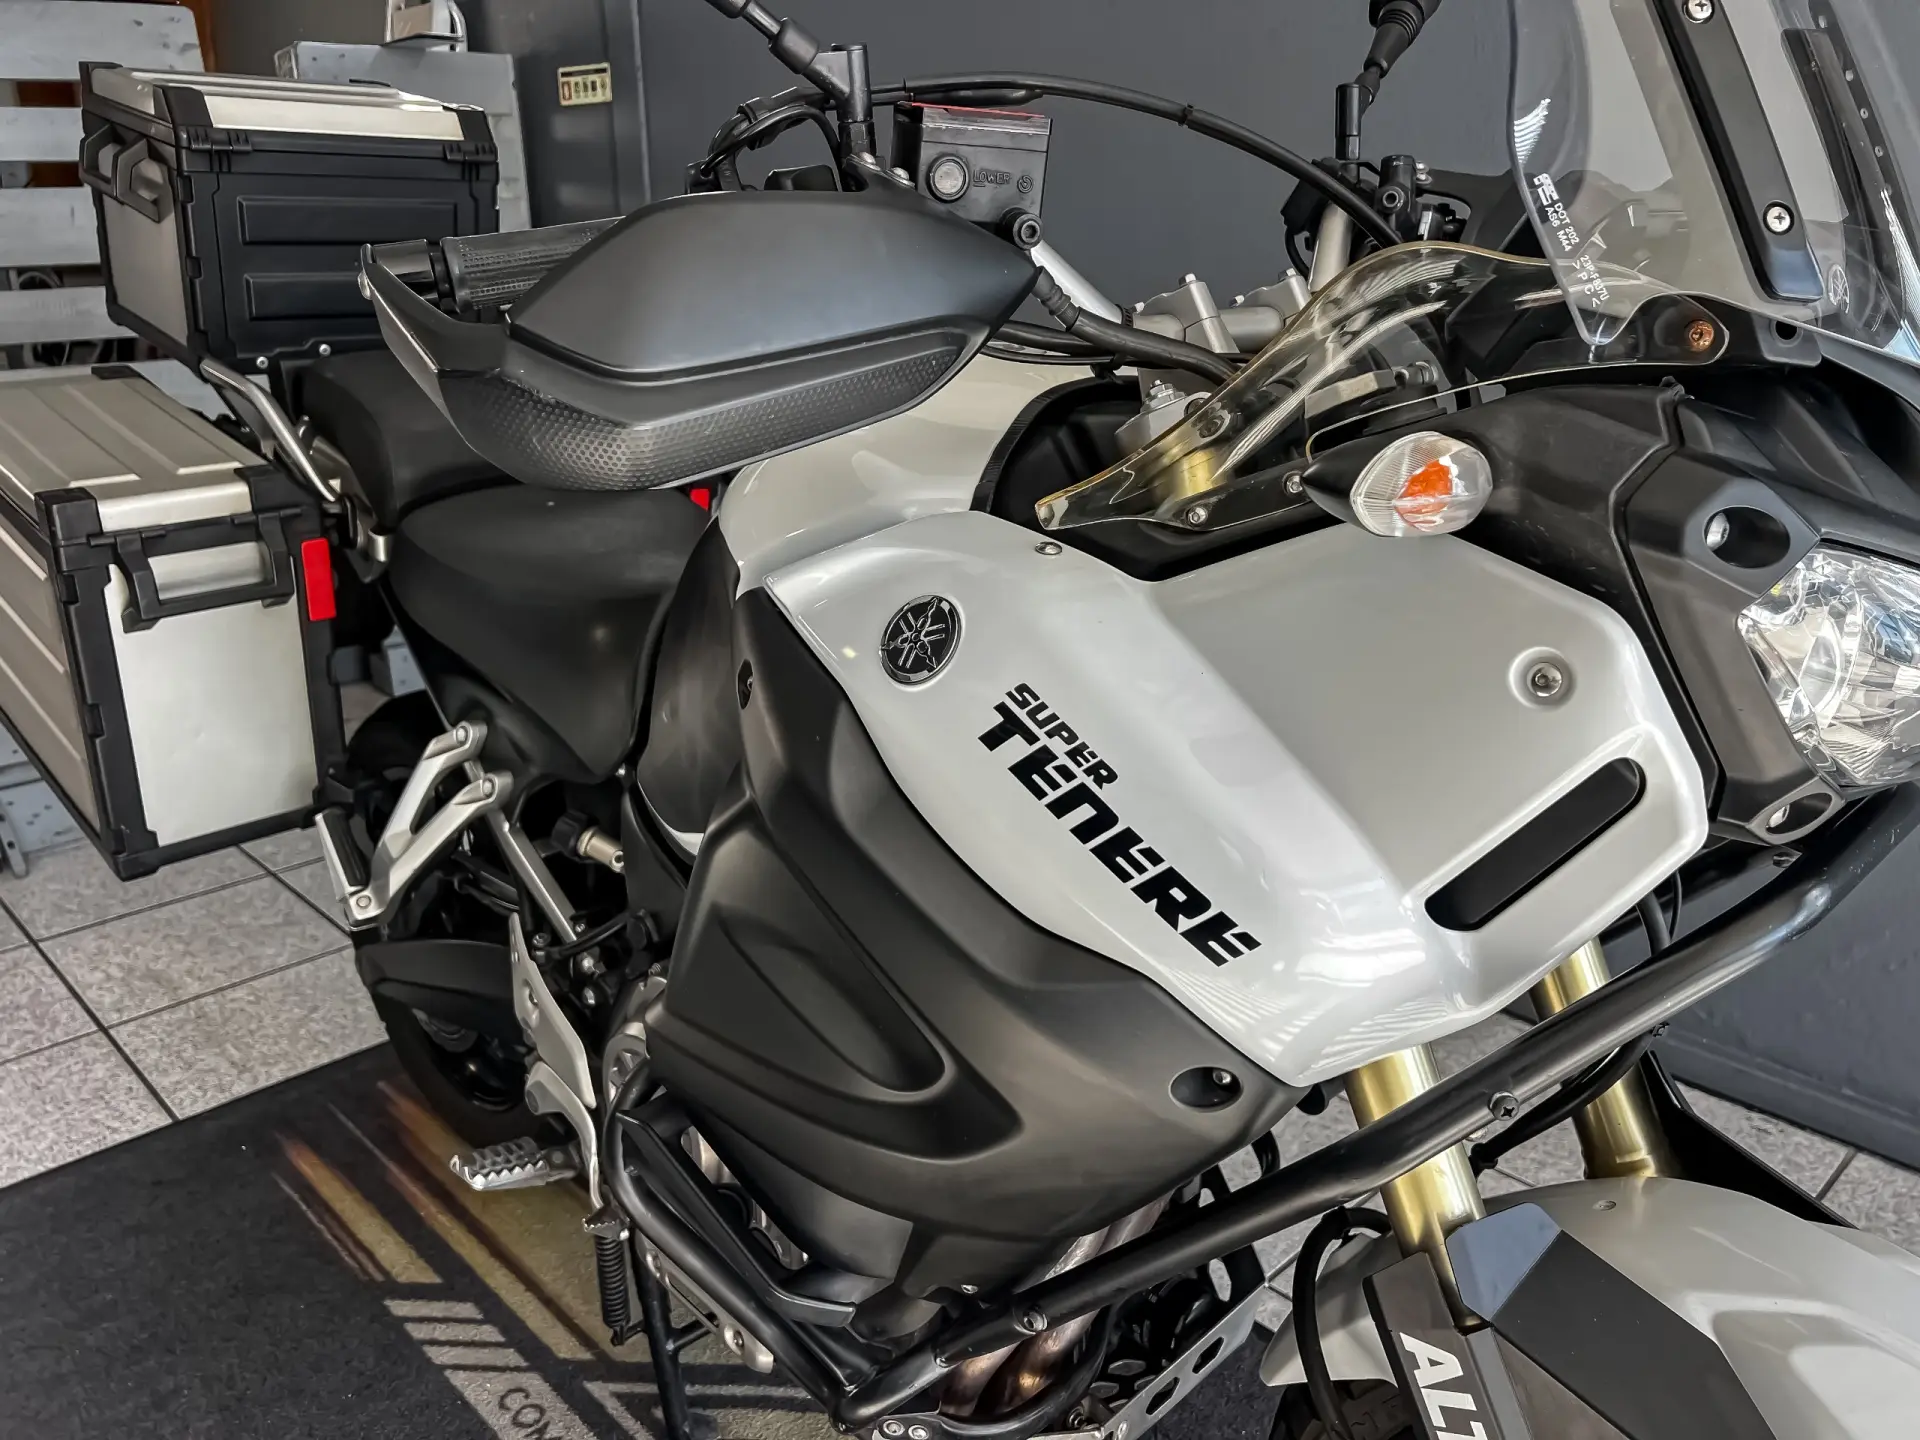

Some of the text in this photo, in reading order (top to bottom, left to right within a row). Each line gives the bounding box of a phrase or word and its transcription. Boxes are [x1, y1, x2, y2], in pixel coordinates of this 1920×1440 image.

[973, 169, 1010, 184] LOWER
[1545, 207, 1572, 251] AS6 M44
[1554, 202, 1579, 244] DOT 202
[1005, 682, 1118, 790] SUPER
[978, 701, 1262, 967] TENERE
